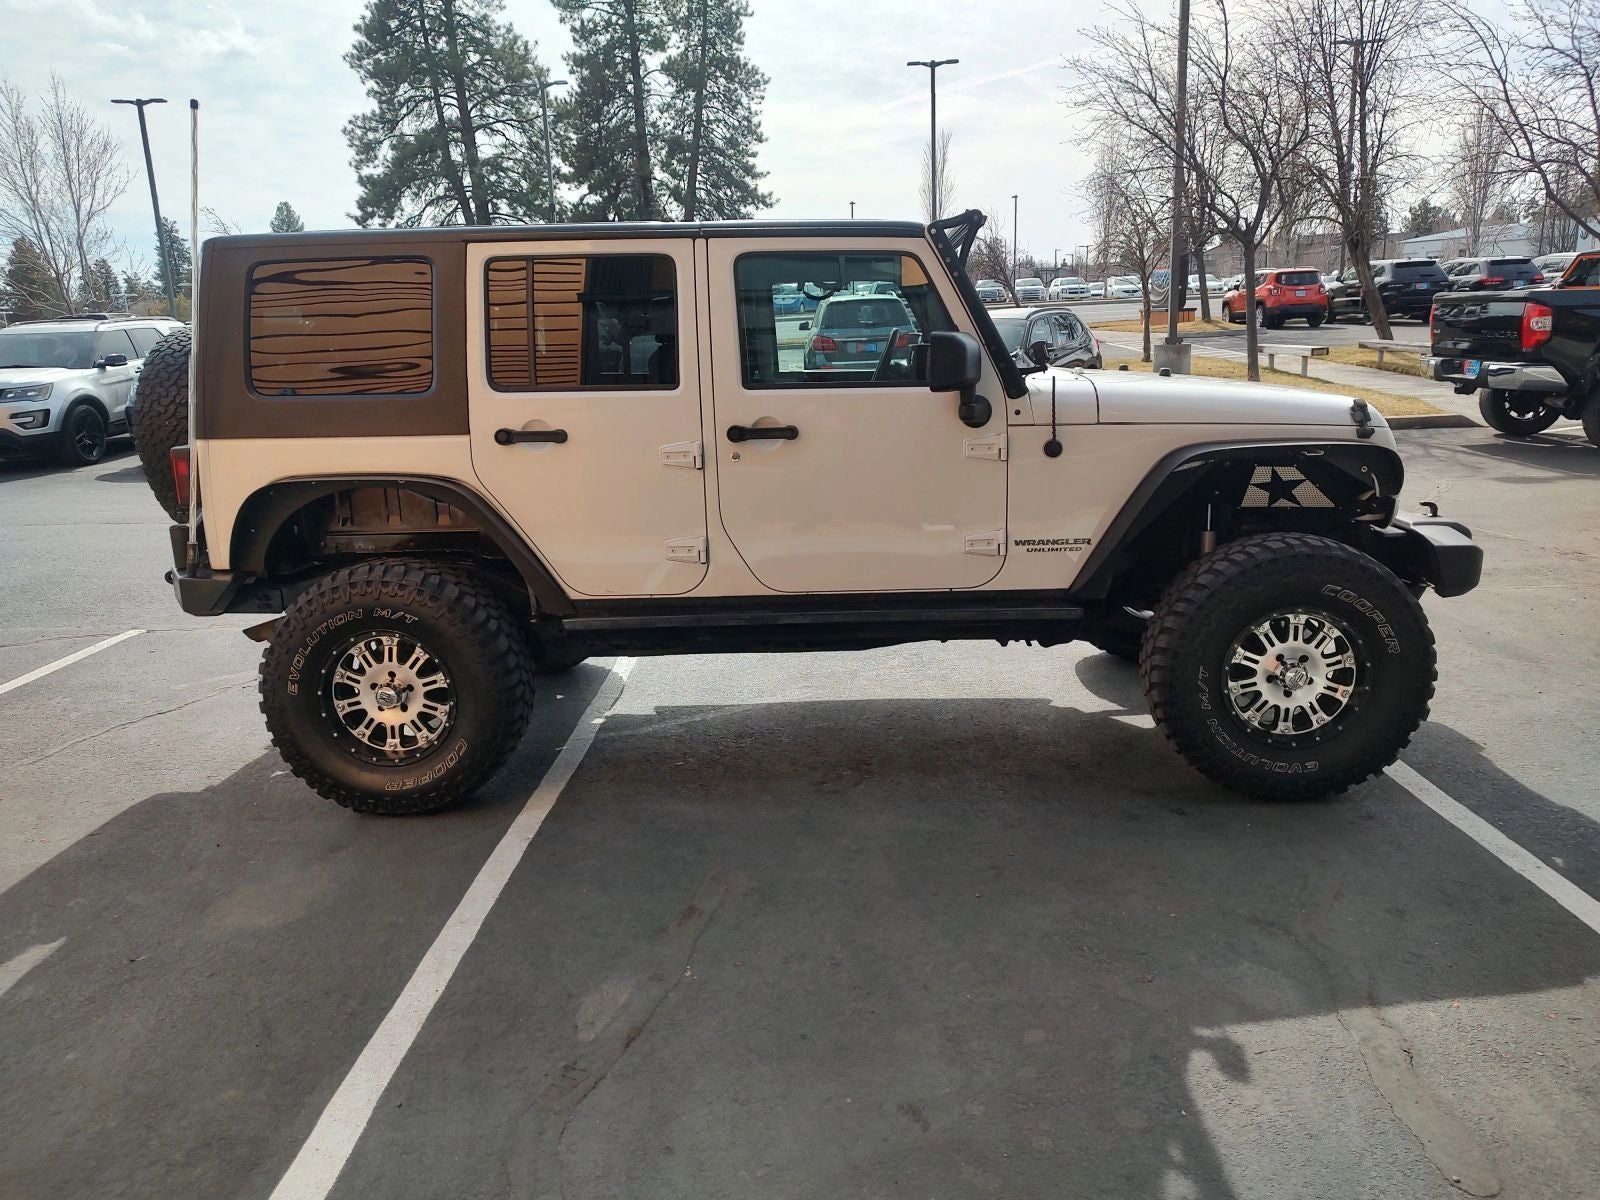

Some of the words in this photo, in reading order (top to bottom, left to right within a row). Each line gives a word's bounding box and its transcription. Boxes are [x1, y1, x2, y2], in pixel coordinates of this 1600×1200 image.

[1014, 538, 1092, 546] WRANGLER
[1320, 584, 1401, 655] COOPER
[287, 609, 363, 696] EVOLUTION
[373, 607, 419, 624] M/T
[385, 738, 469, 791] COOPER
[1207, 718, 1318, 774] EVOLUTION
